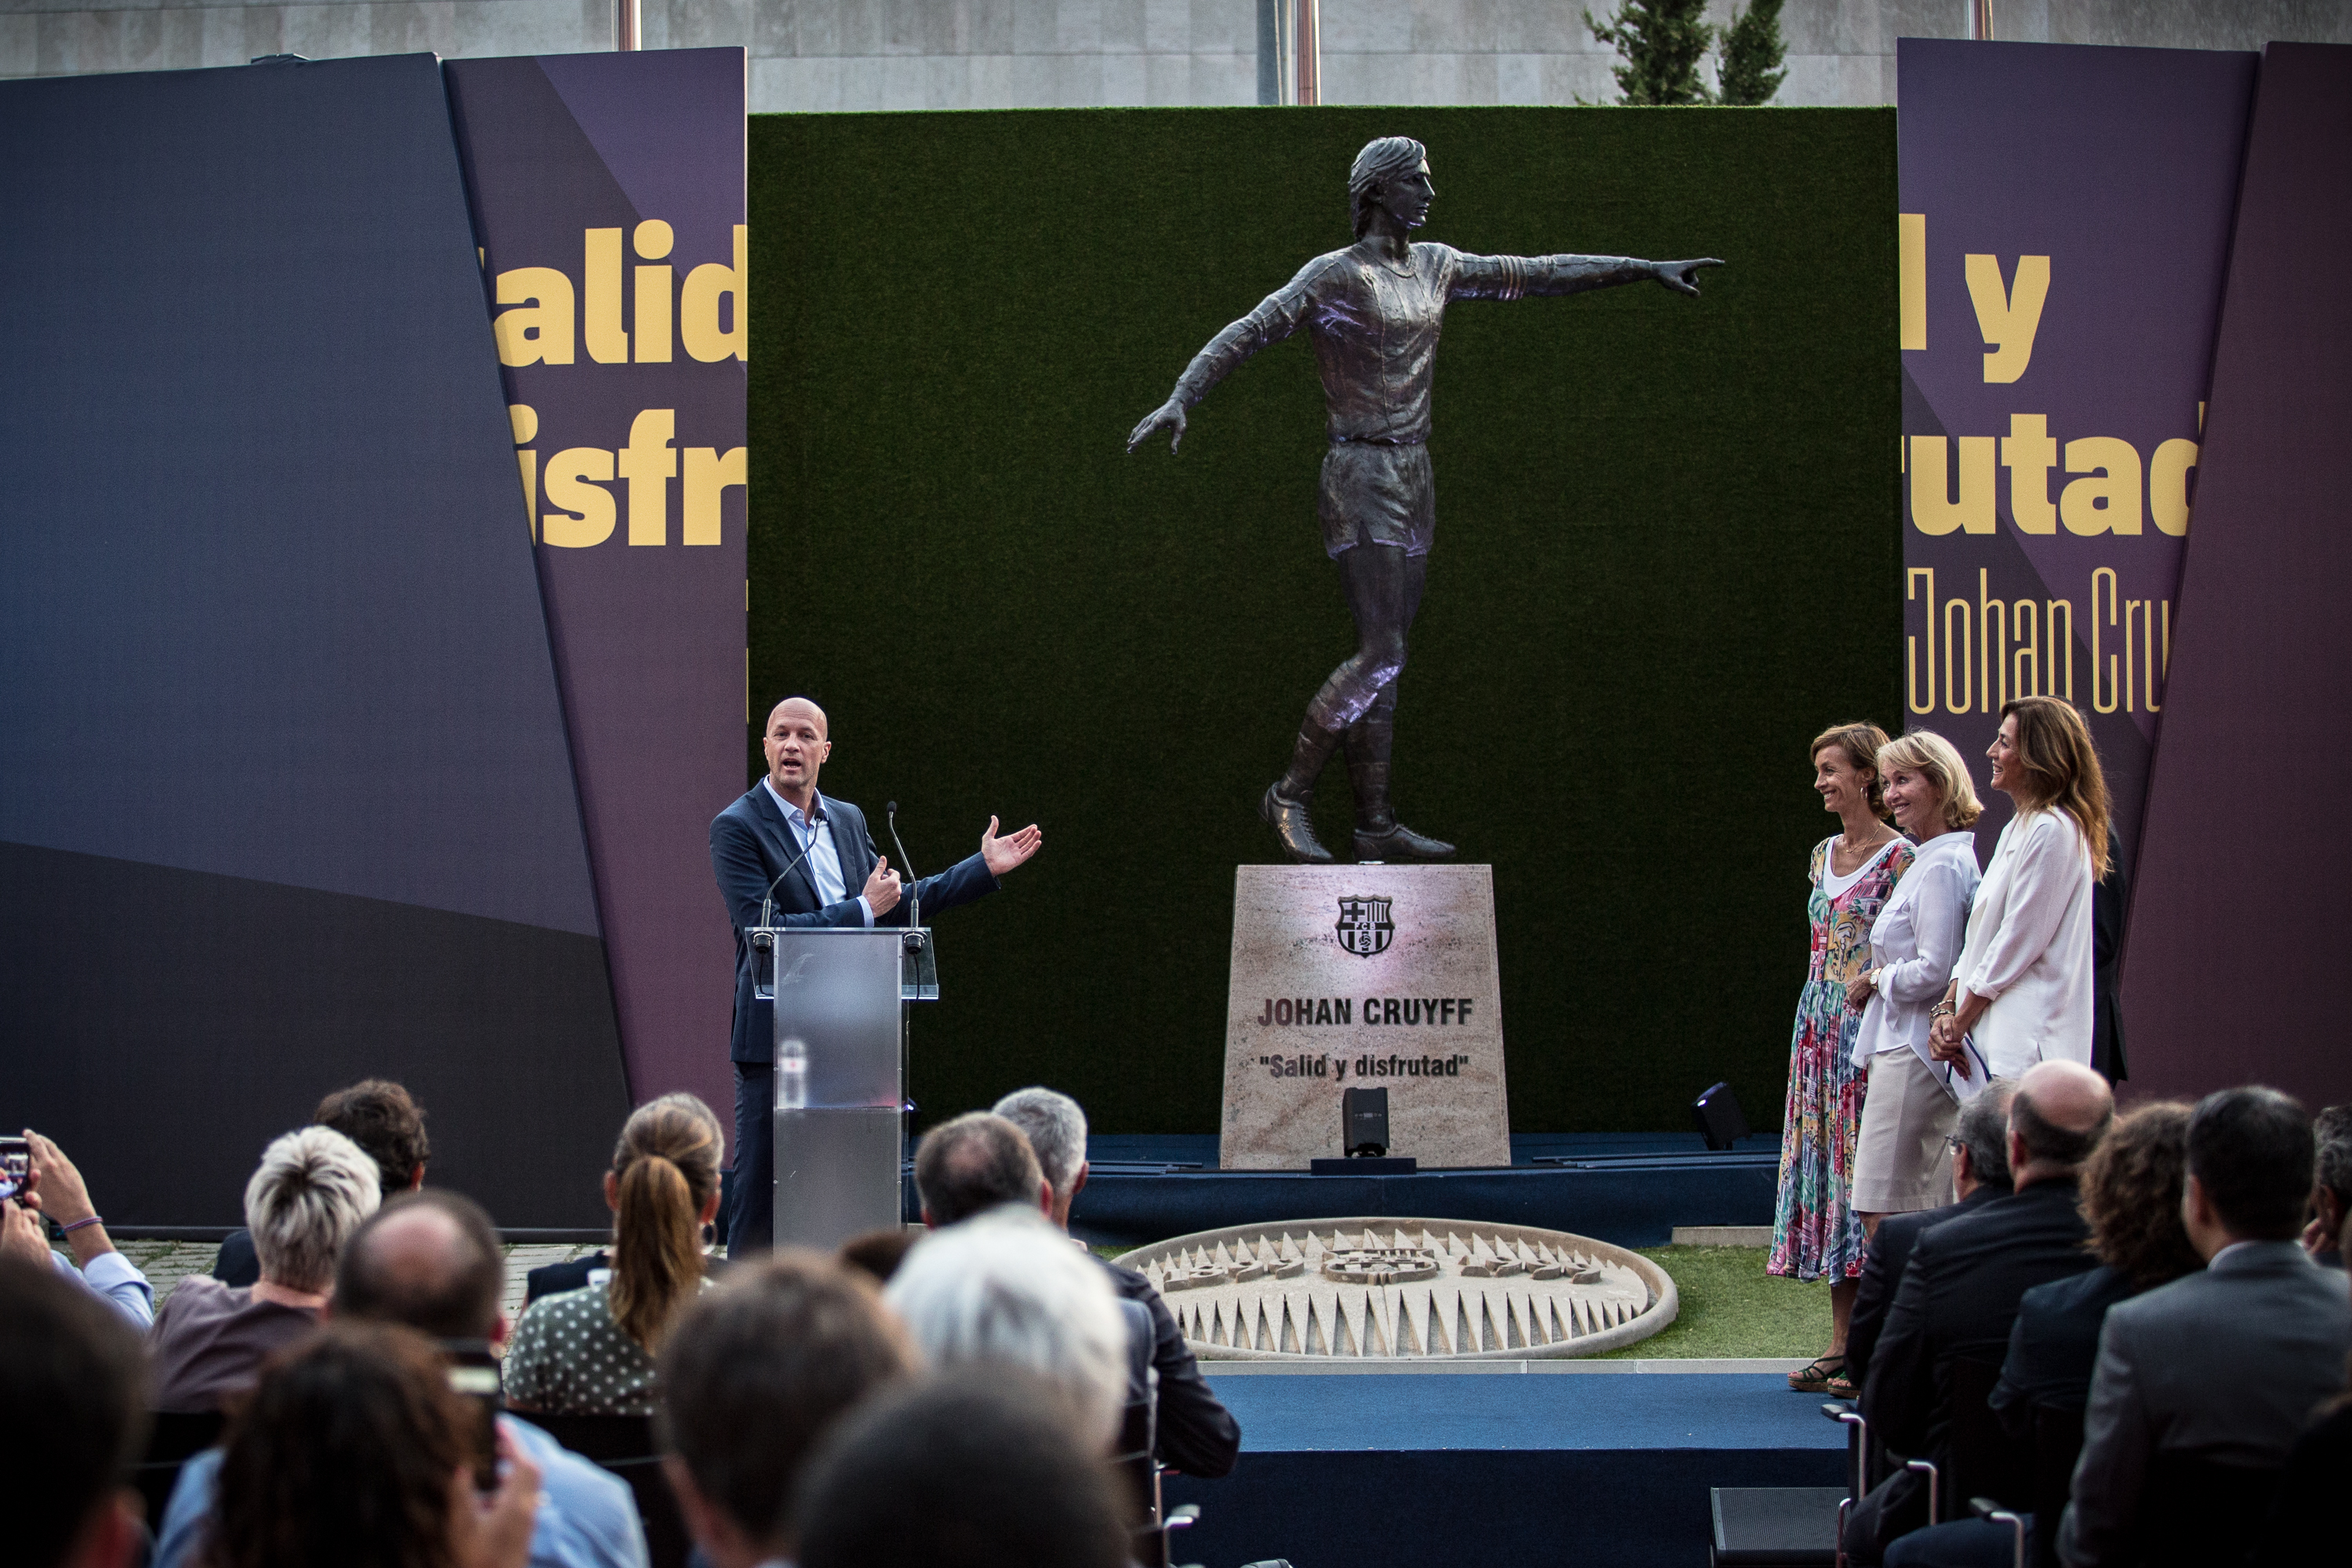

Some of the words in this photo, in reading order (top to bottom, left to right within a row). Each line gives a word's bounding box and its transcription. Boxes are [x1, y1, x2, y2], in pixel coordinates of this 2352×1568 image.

[478, 219, 748, 367] alid
[1964, 253, 2050, 384] y
[1901, 401, 2205, 536] uta
[1907, 568, 2072, 714] Johan
[2092, 567, 2169, 713] Cru
[1354, 922, 1377, 931] FCB
[1258, 998, 1352, 1025] JOHAN
[1363, 998, 1473, 1025] CRUYFF
[1260, 1054, 1327, 1078] "Salid
[1335, 1059, 1347, 1081] y
[1355, 1054, 1469, 1077] disfrutad"
